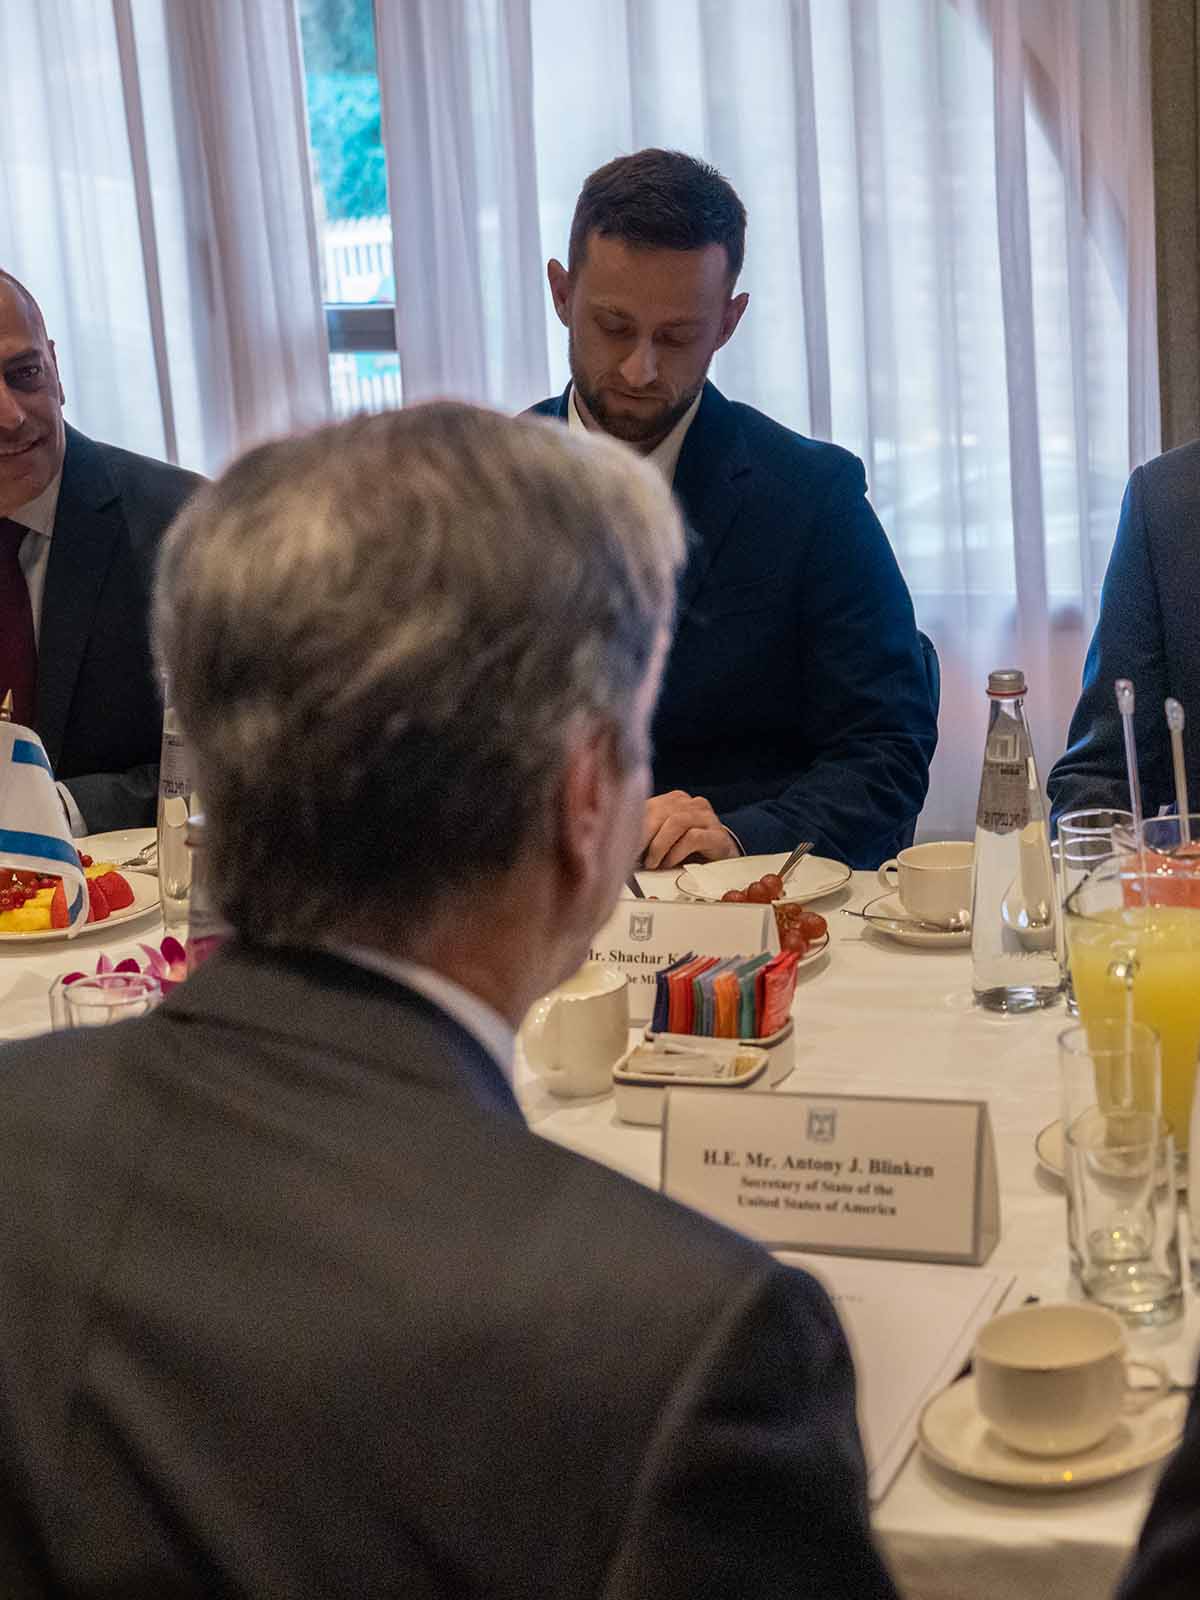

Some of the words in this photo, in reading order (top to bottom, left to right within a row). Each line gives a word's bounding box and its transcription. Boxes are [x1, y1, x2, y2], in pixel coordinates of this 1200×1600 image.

[609, 950, 664, 965] Shachar
[703, 1149, 740, 1167] H.E.
[745, 1151, 776, 1169] Mr.
[783, 1155, 842, 1176] Antony
[848, 1157, 863, 1173] J.
[868, 1159, 935, 1178] Blinken
[740, 1176, 800, 1194] Secretary
[738, 1194, 780, 1209] United
[841, 1202, 897, 1217] America
